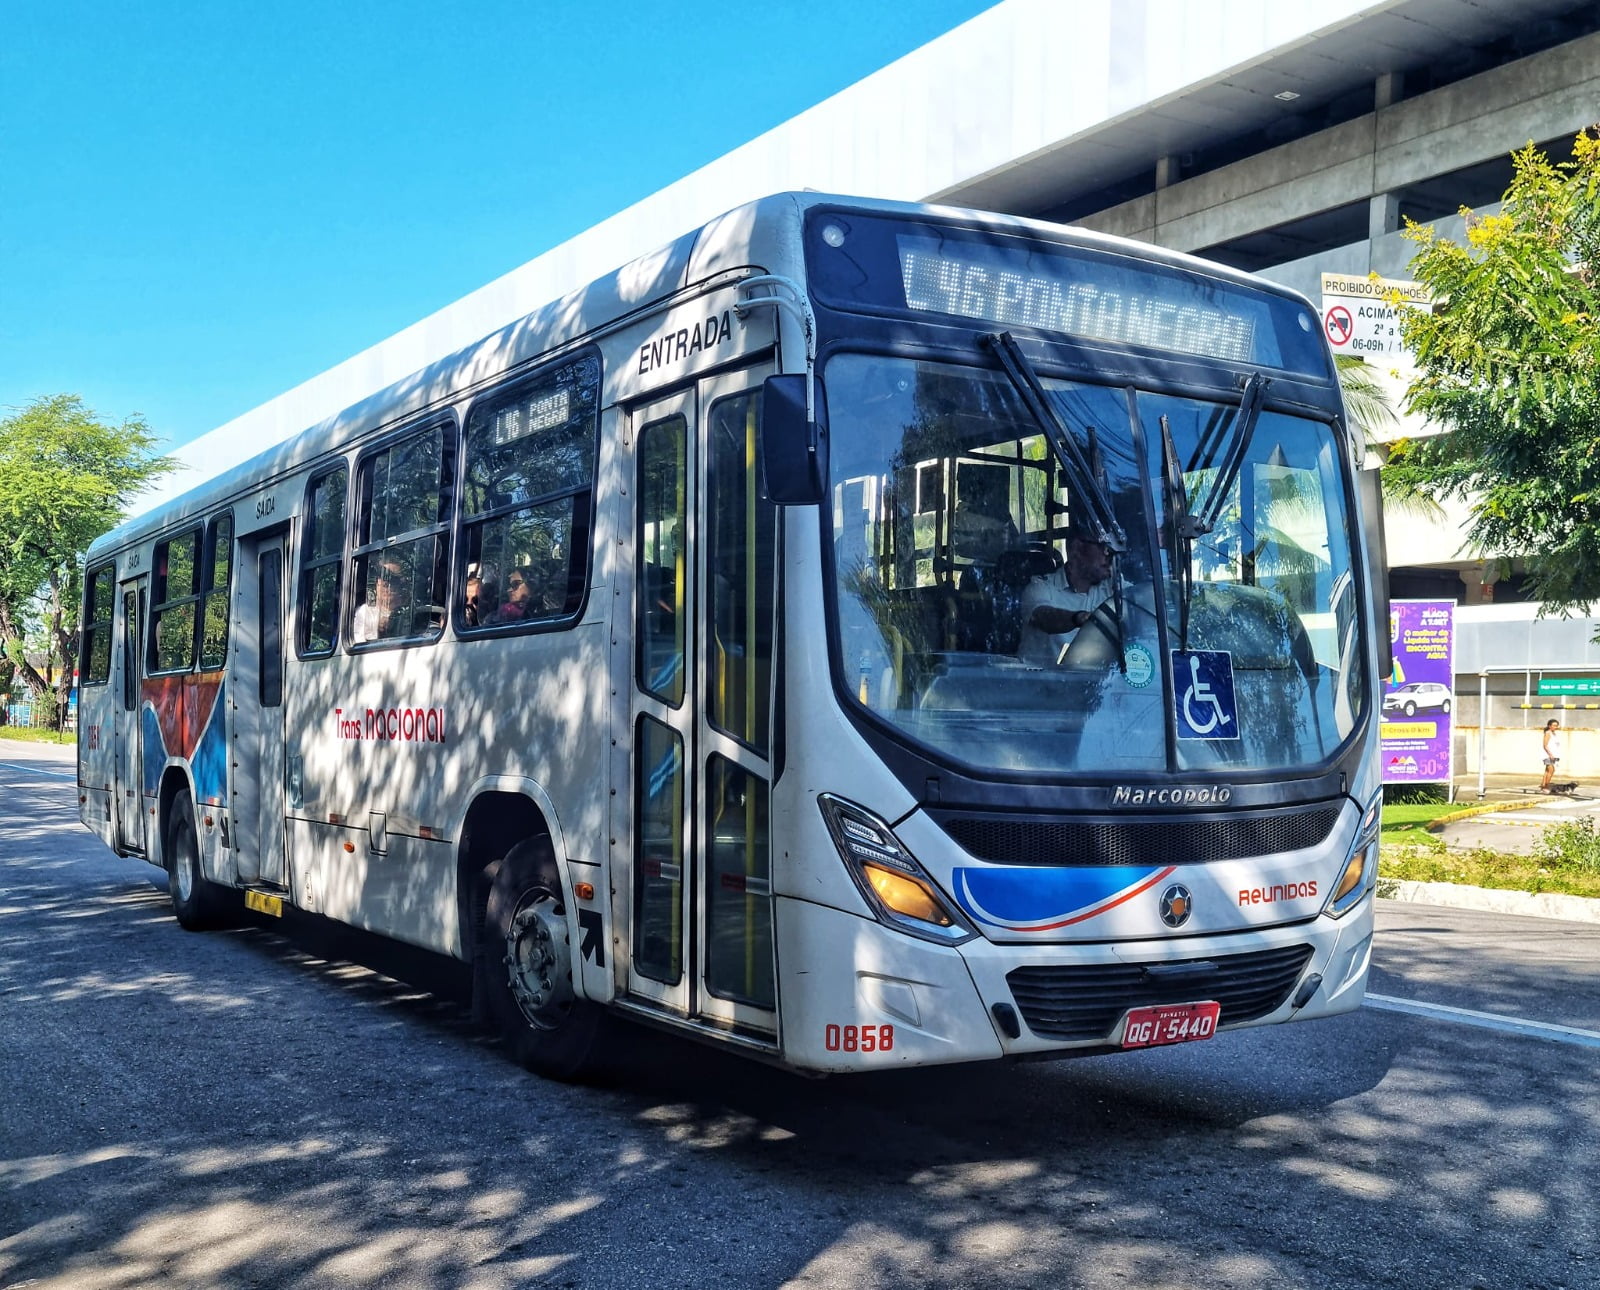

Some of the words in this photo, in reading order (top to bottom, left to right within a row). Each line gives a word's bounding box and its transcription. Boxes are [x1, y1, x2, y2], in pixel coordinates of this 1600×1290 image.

[1325, 280, 1373, 295] PROIBIDO
[995, 271, 1122, 339] PONTA
[1126, 297, 1245, 363] NEGRA
[1358, 306, 1394, 320] ACIMA
[638, 310, 732, 375] ENTRADA
[1388, 327, 1394, 336] a
[1352, 338, 1384, 352] 06-09h
[529, 391, 568, 417] PONTA
[528, 406, 568, 432] NEGRA
[335, 708, 364, 740] Trans.
[366, 708, 446, 744] nacional
[1112, 785, 1231, 805] Marcopolo
[825, 1023, 894, 1053] 0858
